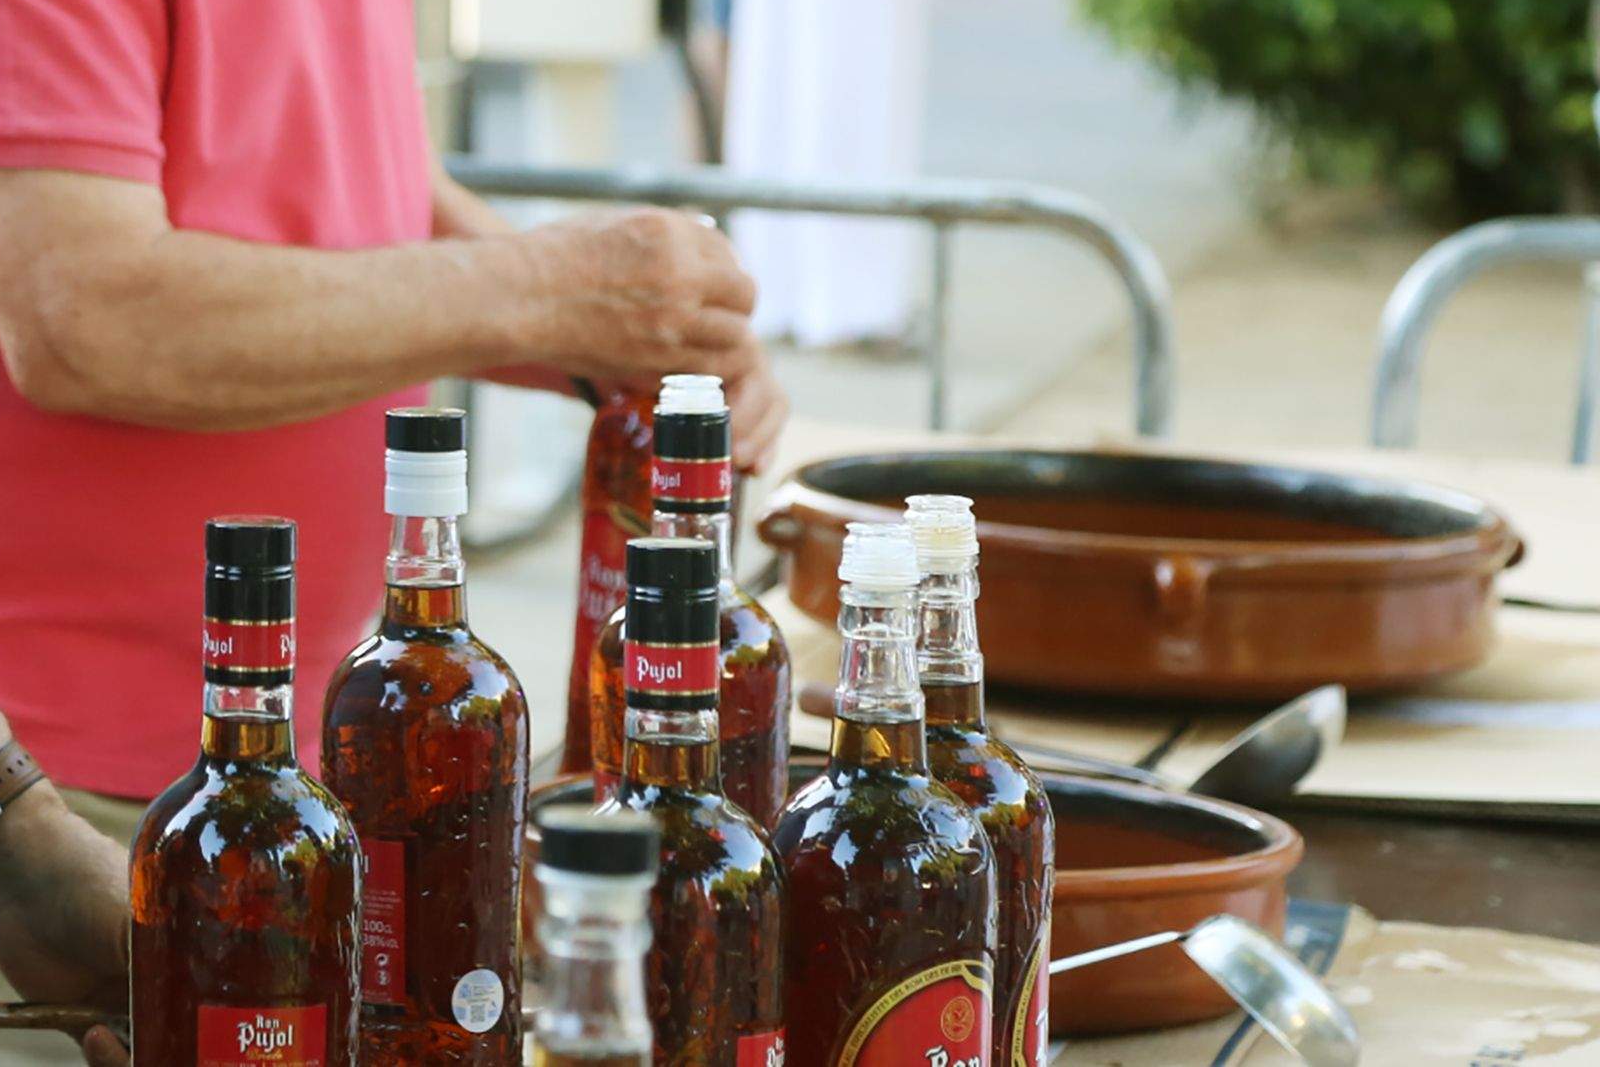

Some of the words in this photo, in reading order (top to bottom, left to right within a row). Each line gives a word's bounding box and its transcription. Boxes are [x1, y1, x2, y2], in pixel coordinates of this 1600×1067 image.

[636, 656, 683, 684] Pujol
[255, 1014, 280, 1029] Ron
[237, 1021, 294, 1053] Pujol
